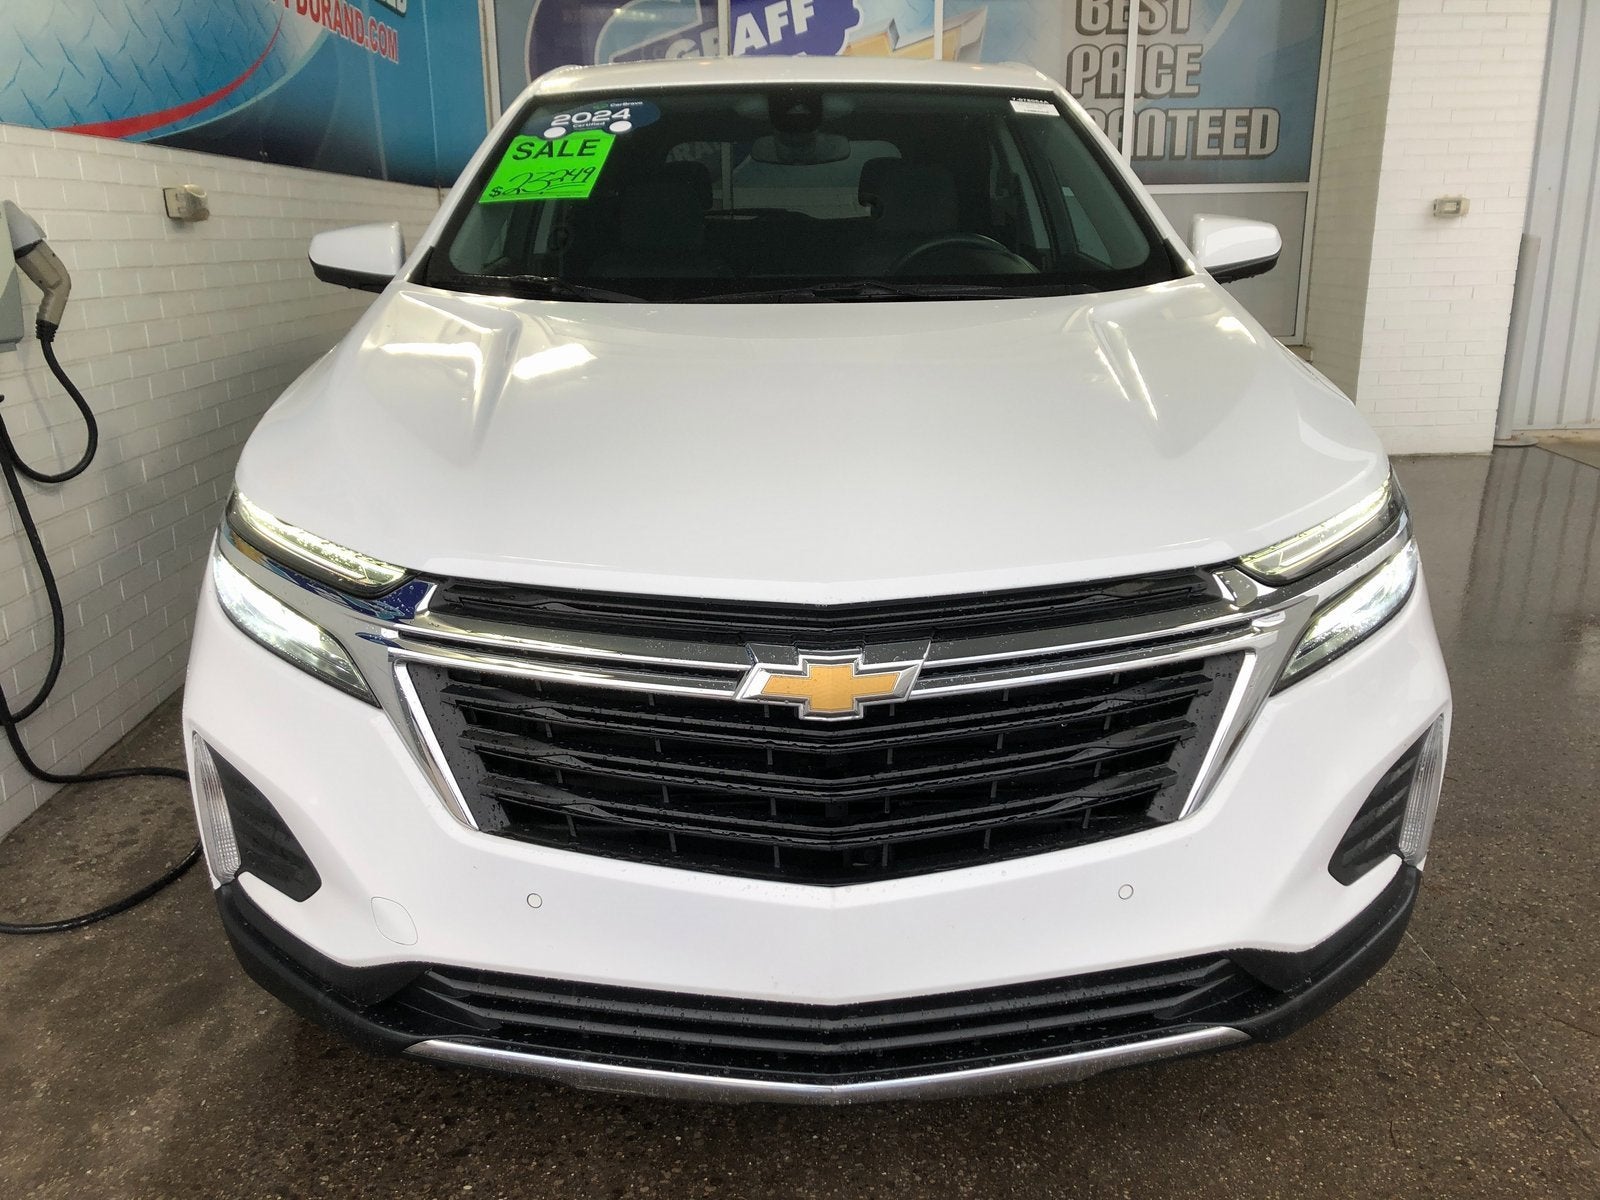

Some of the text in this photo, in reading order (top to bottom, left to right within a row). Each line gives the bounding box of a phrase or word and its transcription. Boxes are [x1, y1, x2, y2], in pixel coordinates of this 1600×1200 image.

[1076, 0, 1191, 35] BEST
[1066, 43, 1203, 99] PRICE
[550, 107, 631, 127] 2024
[512, 138, 600, 160] SALE
